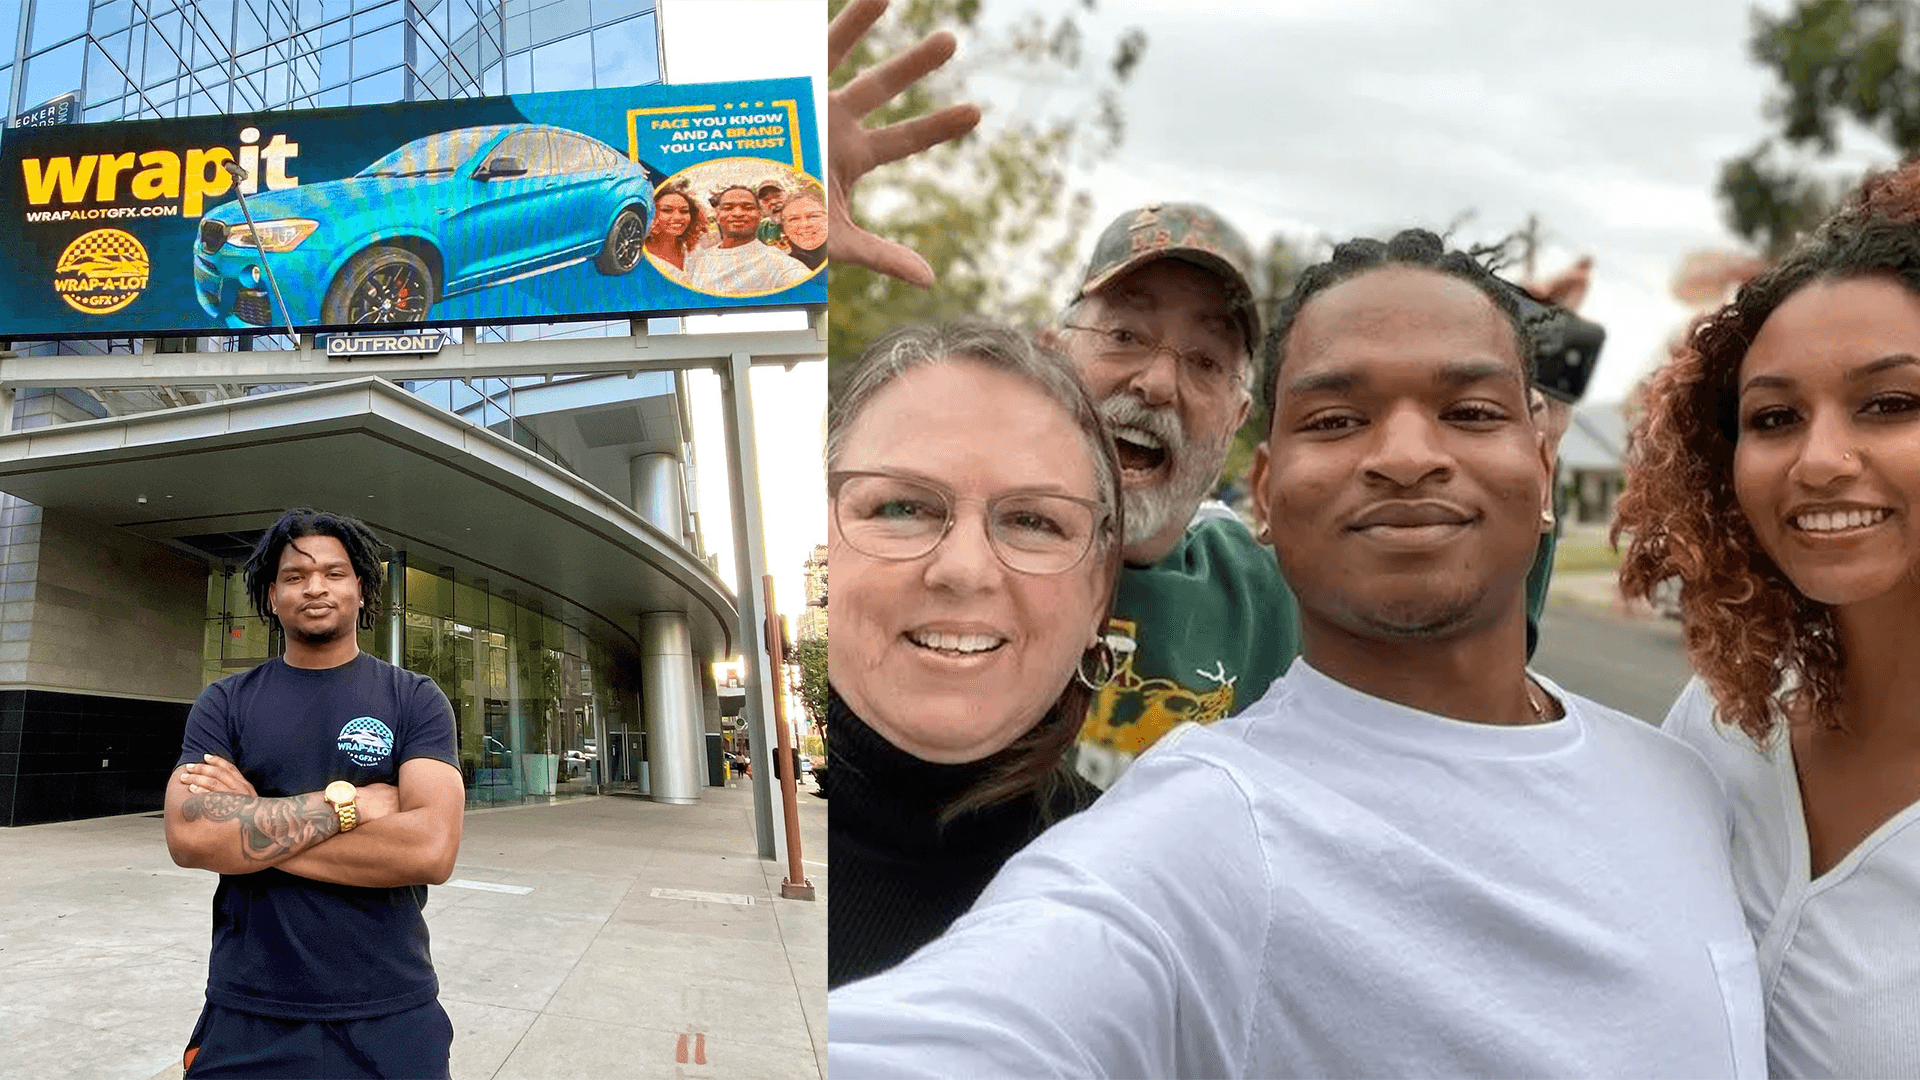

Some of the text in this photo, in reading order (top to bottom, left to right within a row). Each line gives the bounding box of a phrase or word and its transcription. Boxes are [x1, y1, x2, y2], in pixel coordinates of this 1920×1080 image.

[651, 113, 783, 130] FACE YOU KNOW
[672, 125, 784, 141] AND A BRAND
[660, 137, 785, 154] YOU CAN TRUST
[26, 205, 178, 222] WRAPALOTGFX.COM
[54, 276, 148, 292] WRAP-A-LOT
[89, 295, 112, 306] GFX
[331, 335, 439, 352] OUTFRONT
[358, 754, 373, 763] GFX
